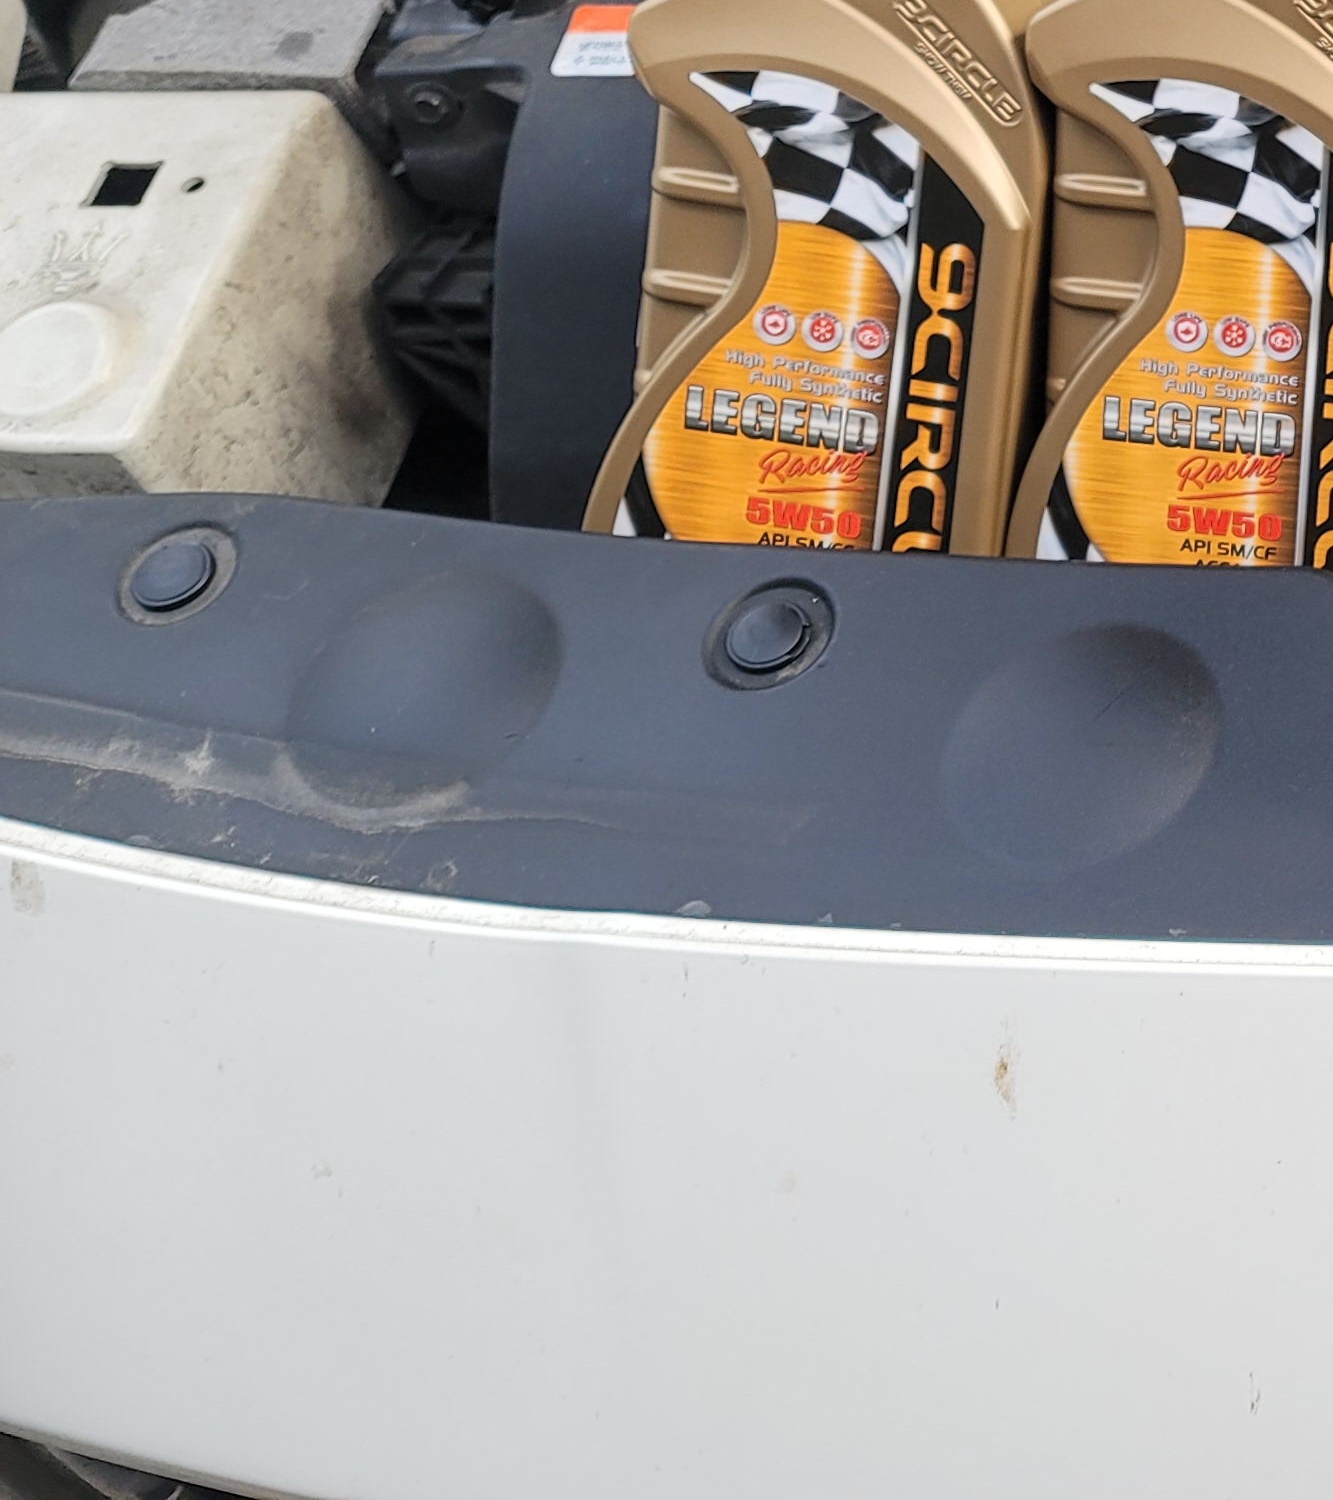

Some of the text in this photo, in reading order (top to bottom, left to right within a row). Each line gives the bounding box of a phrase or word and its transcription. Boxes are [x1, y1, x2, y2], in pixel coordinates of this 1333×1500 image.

[725, 349, 886, 386] High Performance
[1139, 357, 1299, 387] High Performance
[749, 370, 884, 404] Fully Synthetic
[1163, 379, 1298, 405] Fully Synthetic
[684, 384, 880, 455] LEGEND
[1102, 395, 1296, 457] LEGEND
[758, 447, 869, 484] Racing
[1176, 452, 1286, 492] Racing
[745, 496, 862, 539] 5W50
[1166, 503, 1283, 542] 5W50
[1180, 538, 1278, 560] API SM/CF
